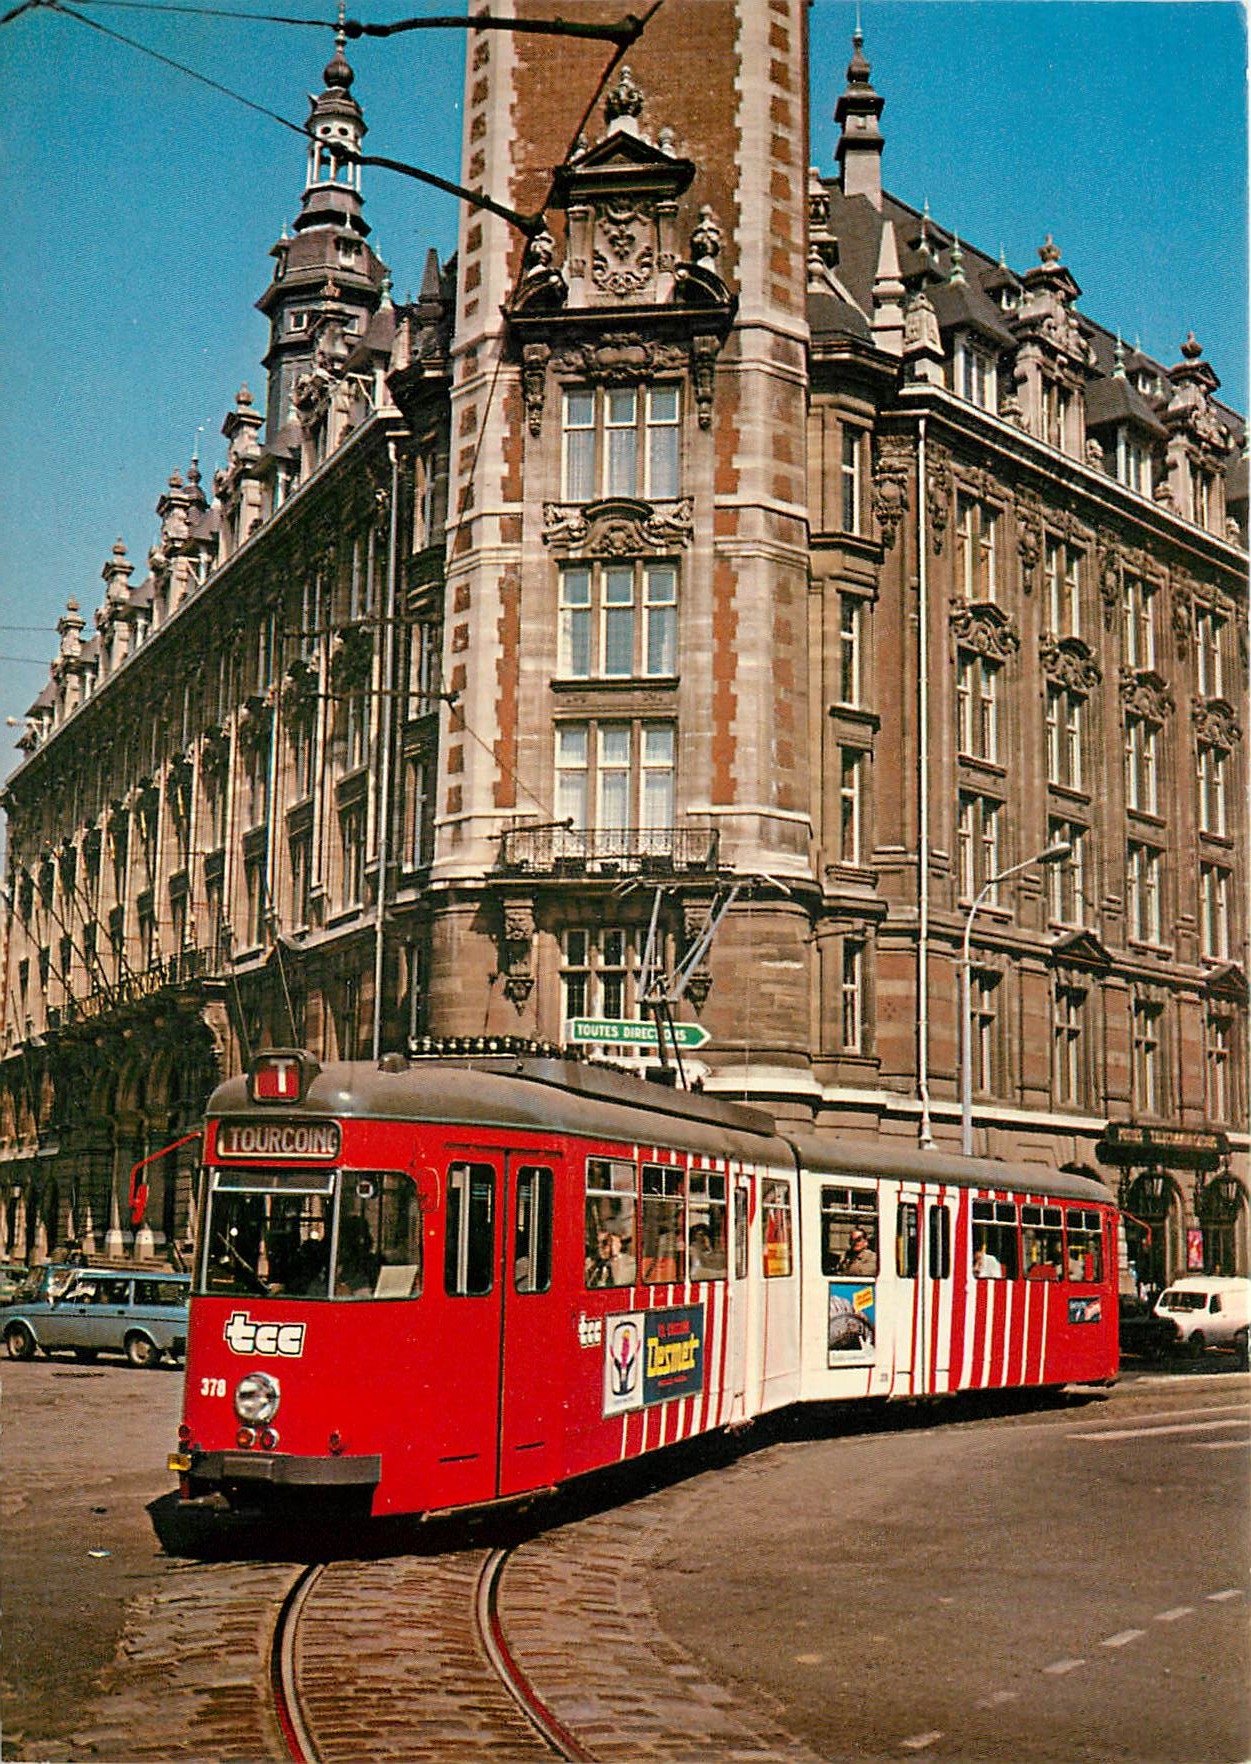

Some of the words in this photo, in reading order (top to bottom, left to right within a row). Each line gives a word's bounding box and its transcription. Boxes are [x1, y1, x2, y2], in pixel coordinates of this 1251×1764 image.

[577, 1024, 619, 1037] TOUTES
[269, 1058, 295, 1094] T
[223, 1310, 306, 1357] tcc
